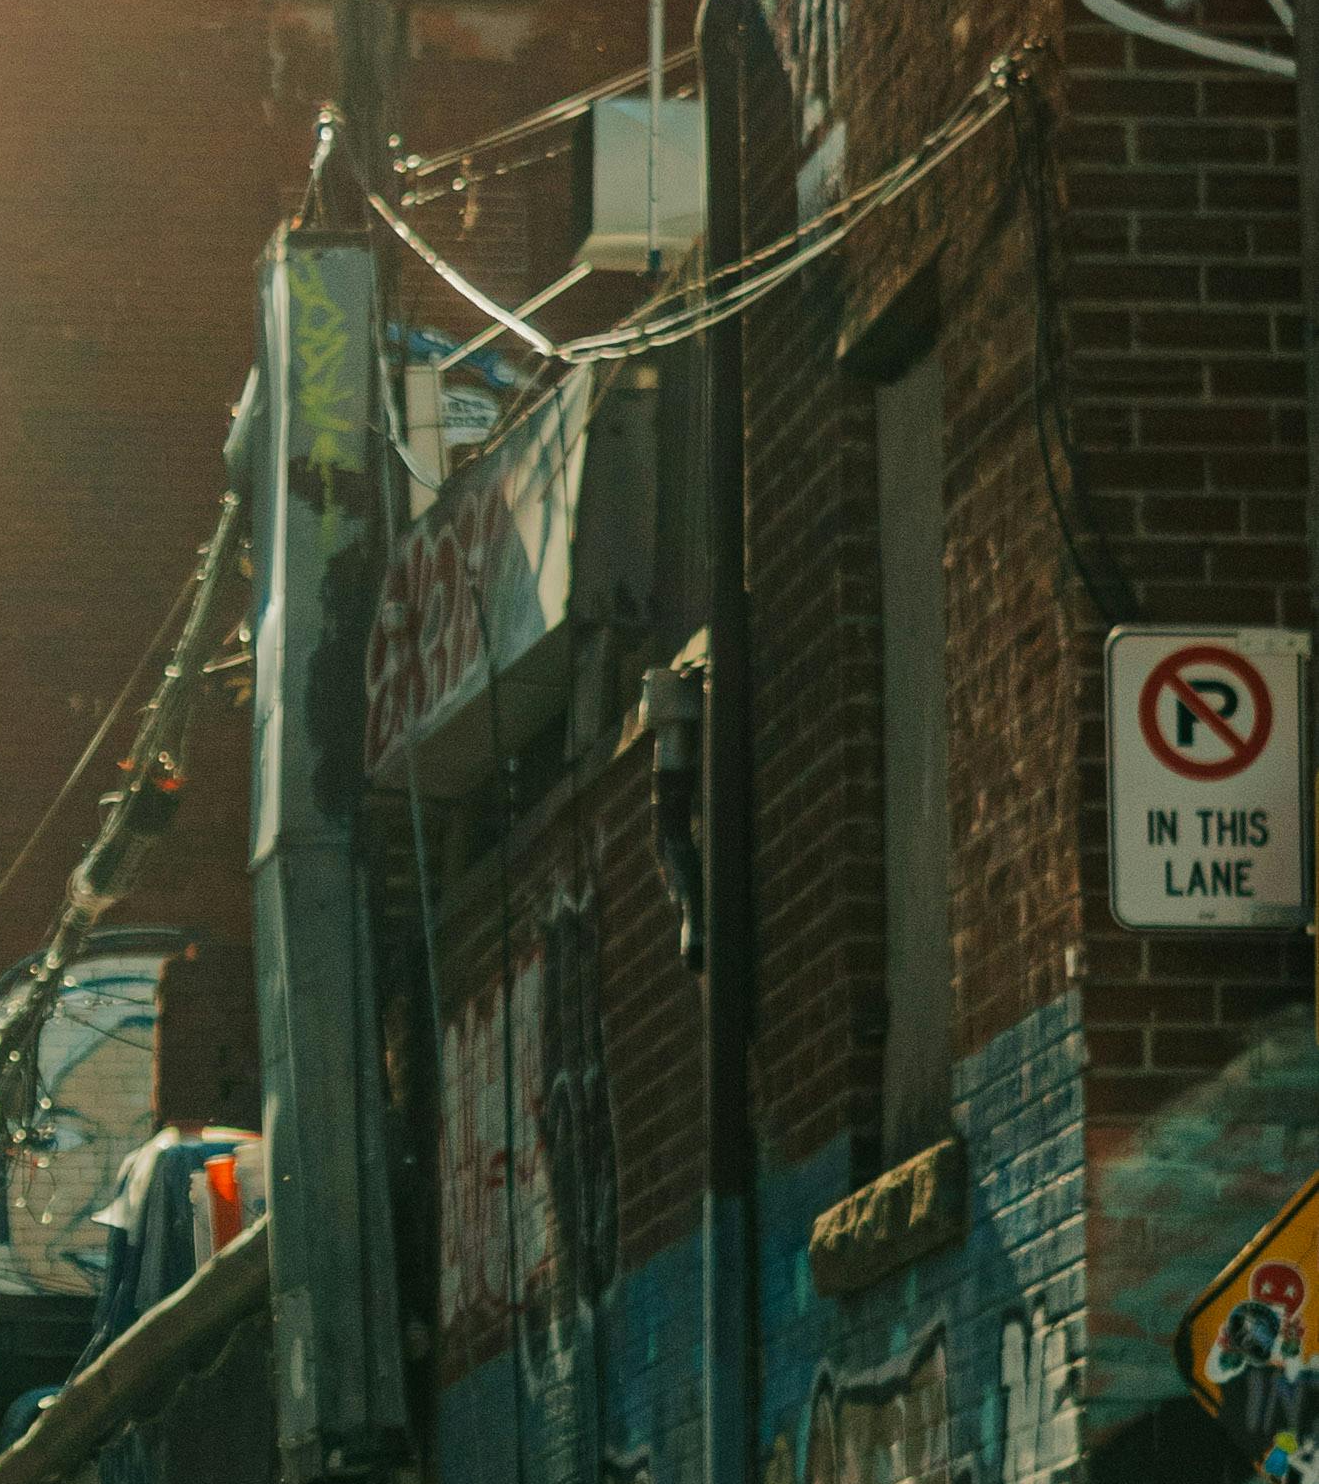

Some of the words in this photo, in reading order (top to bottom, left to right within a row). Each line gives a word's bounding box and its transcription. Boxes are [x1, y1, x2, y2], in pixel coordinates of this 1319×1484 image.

[1146, 808, 1178, 846] IN
[1196, 808, 1269, 847] THIS
[1165, 861, 1255, 897] LANE
